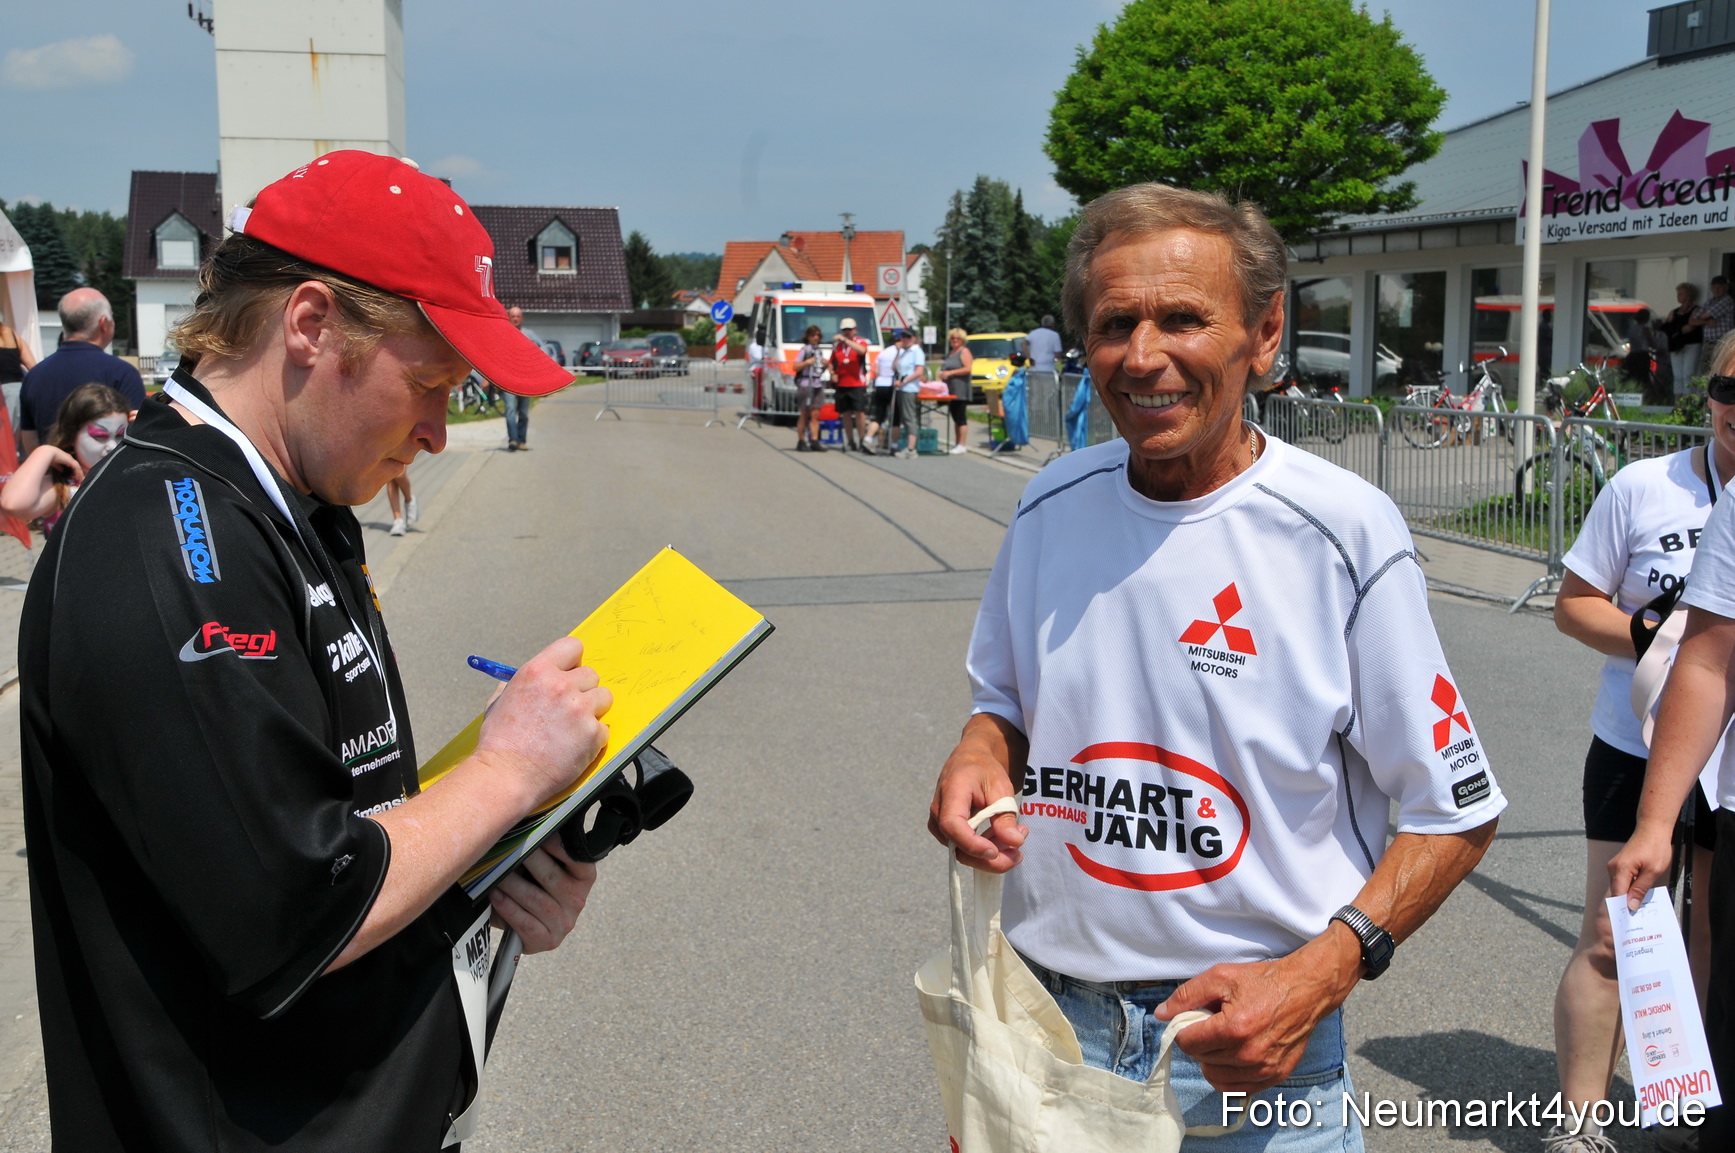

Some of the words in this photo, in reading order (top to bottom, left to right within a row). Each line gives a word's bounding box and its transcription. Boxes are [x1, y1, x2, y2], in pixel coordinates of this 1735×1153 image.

[1547, 217, 1627, 241] Kiga-Versand
[1632, 215, 1653, 230] mit
[1658, 212, 1698, 228] Ideen
[1704, 206, 1728, 224] und
[1187, 645, 1246, 666] MITSUBISHI
[1190, 661, 1238, 679] MOTORS
[1196, 797, 1217, 819] &
[1085, 812, 1224, 859] JÄNIG
[1640, 1070, 1711, 1111] URKUNDE
